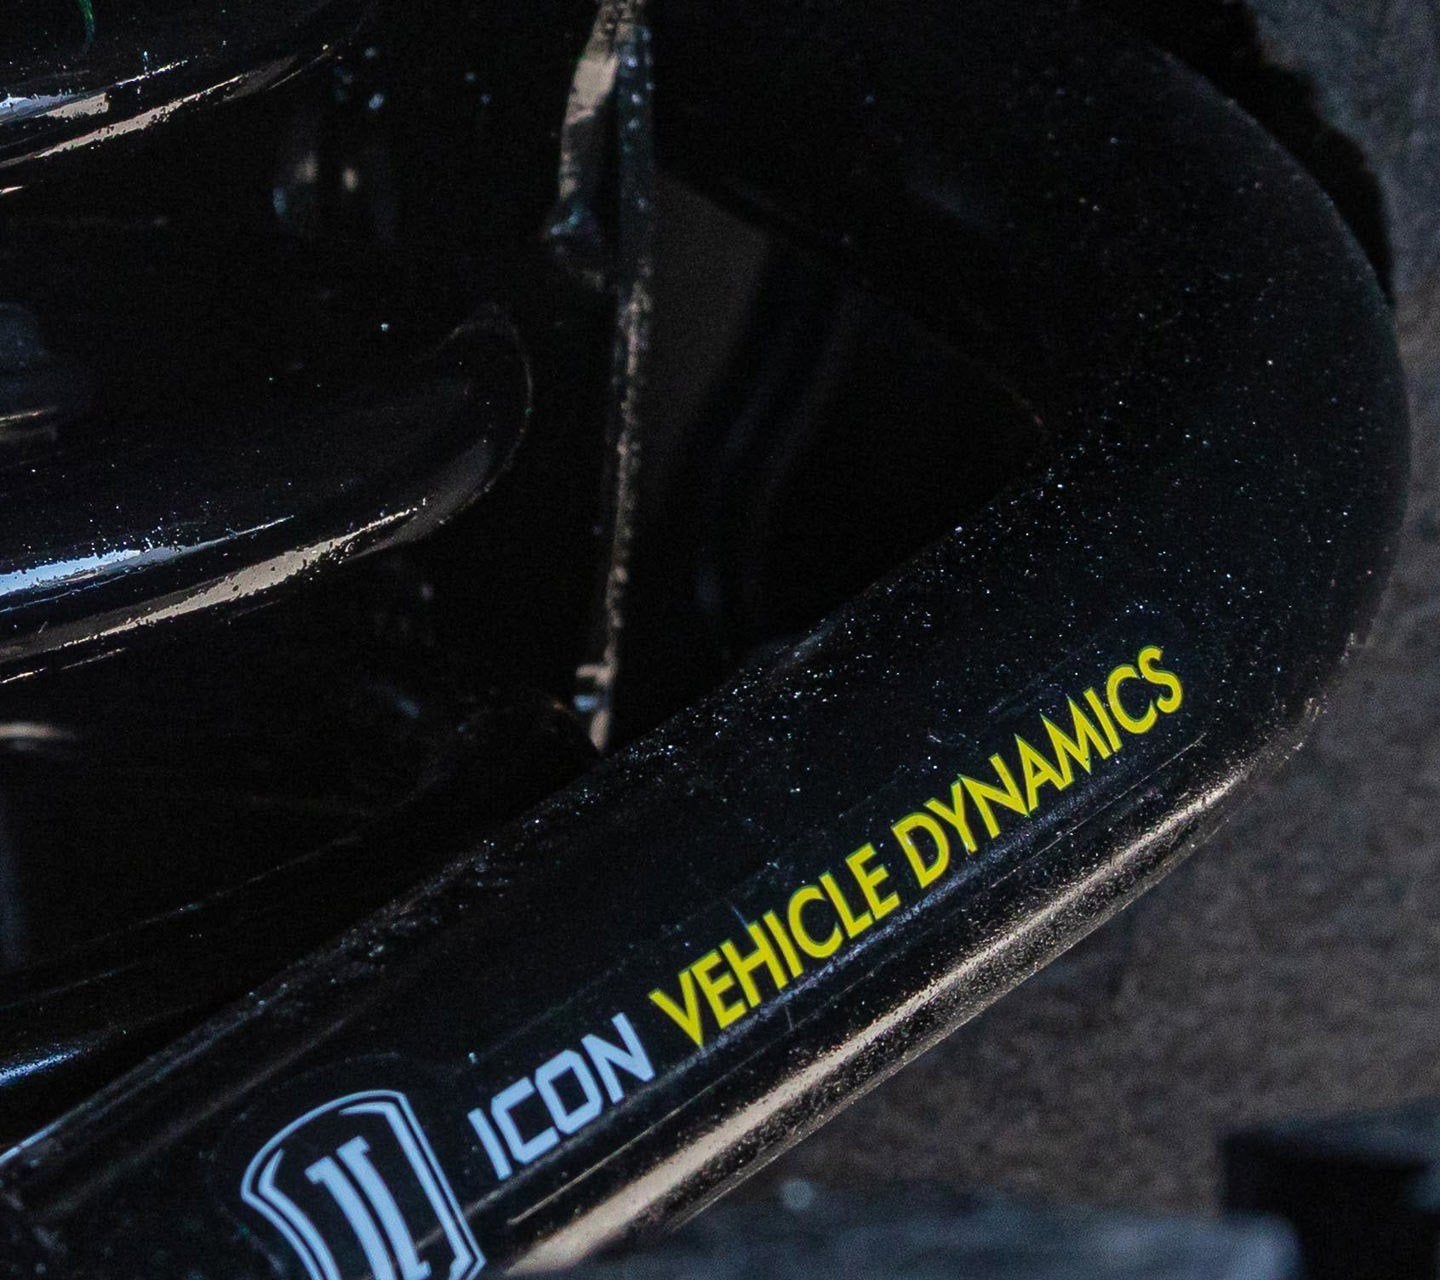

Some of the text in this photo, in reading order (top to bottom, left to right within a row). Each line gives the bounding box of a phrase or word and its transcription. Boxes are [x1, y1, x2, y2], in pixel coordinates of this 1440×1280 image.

[468, 646, 1183, 1180] ICON VEHICLE DYNAMICS
